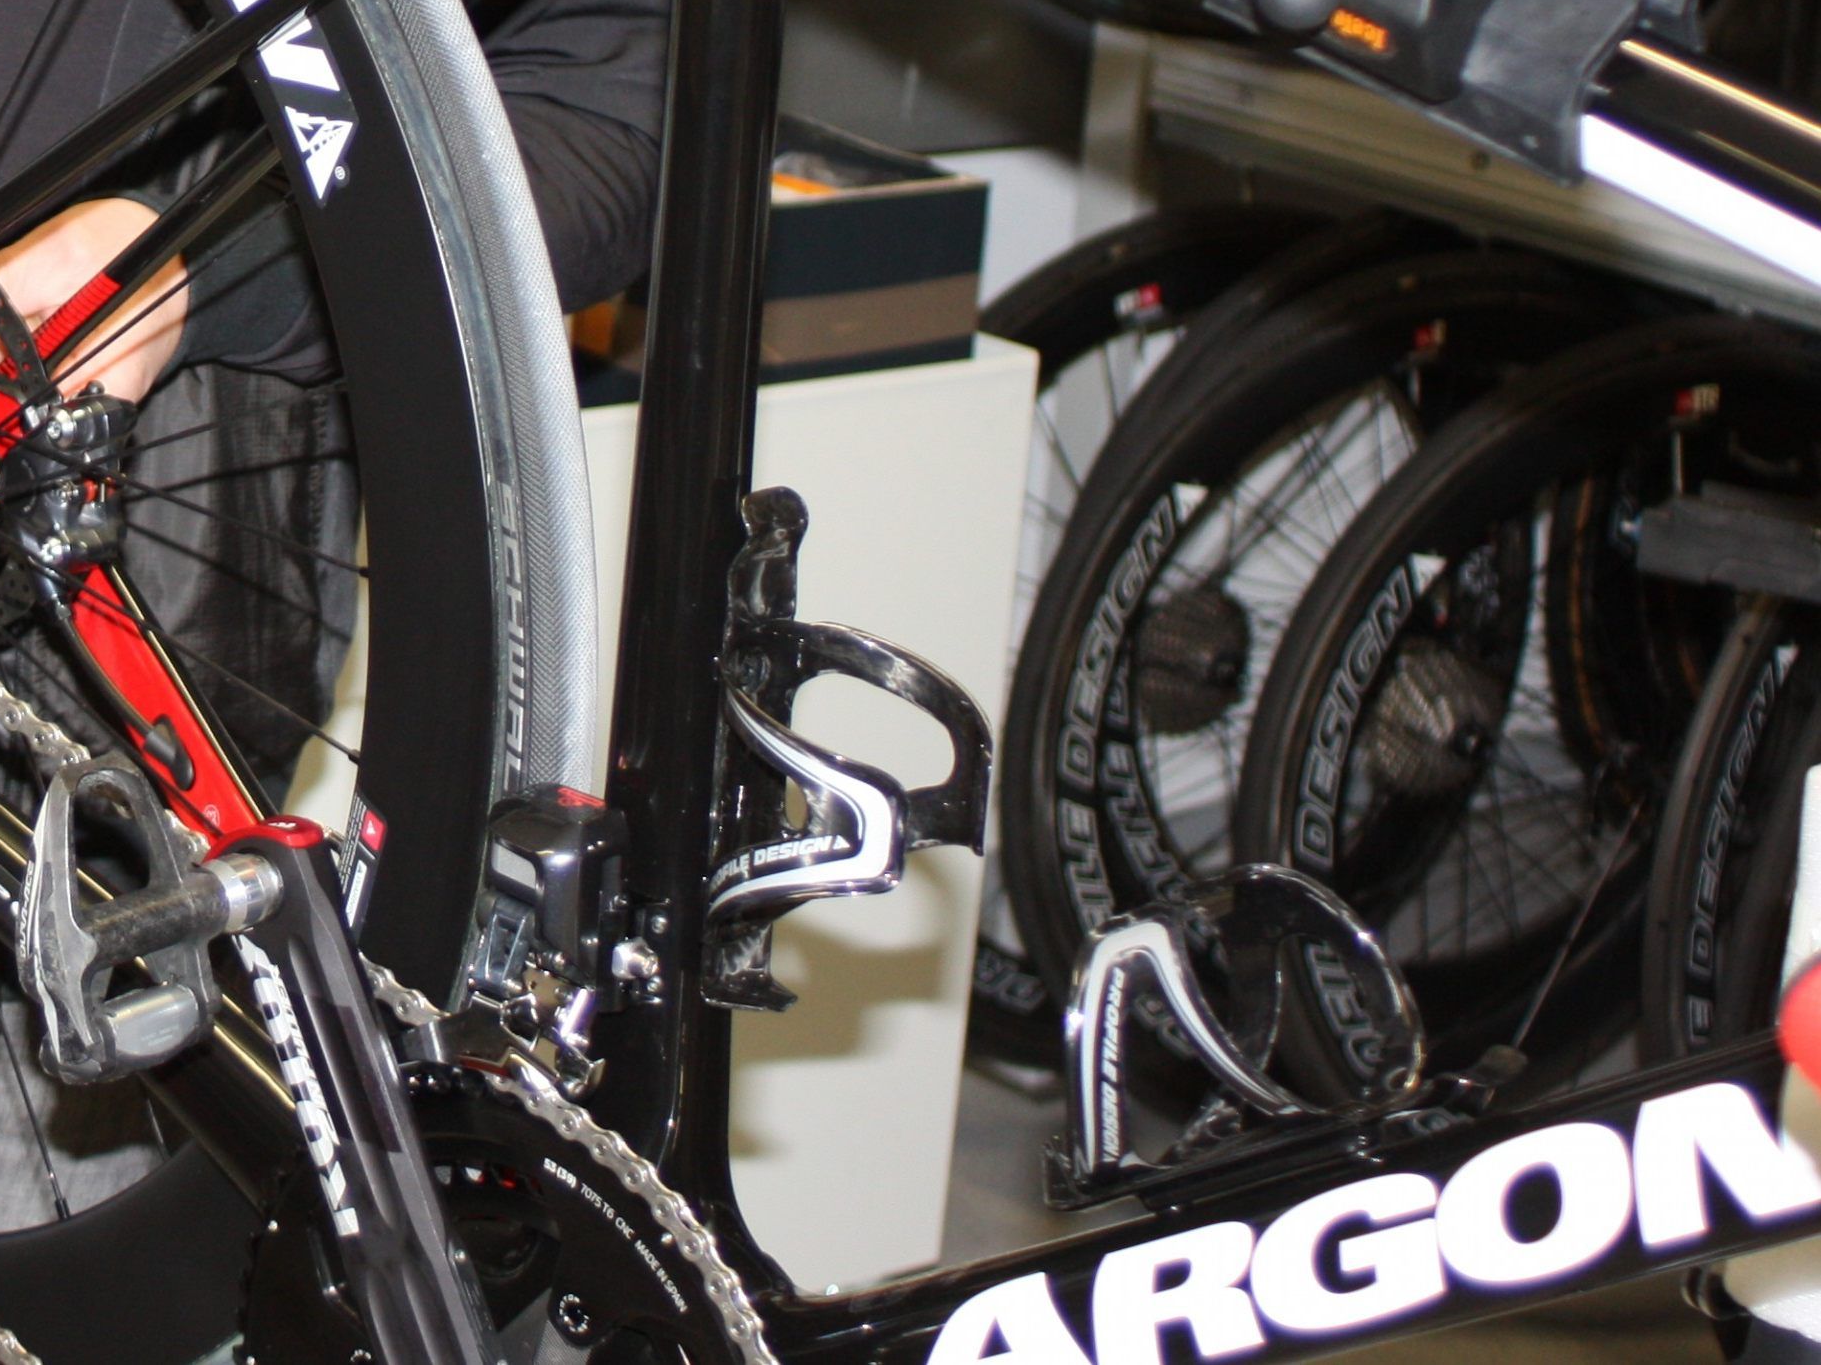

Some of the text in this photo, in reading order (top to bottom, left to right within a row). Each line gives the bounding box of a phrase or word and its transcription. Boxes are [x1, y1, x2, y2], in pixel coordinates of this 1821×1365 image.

[498, 482, 526, 792] SCHWAL
[1057, 493, 1177, 792] DESIGN
[1294, 565, 1414, 870] DESIGN
[753, 834, 834, 867] DESIGN
[1101, 967, 1126, 1163] PROFILE DESIGN
[580, 1183, 602, 1208] 7075
[614, 1216, 635, 1240] CNC
[633, 1239, 661, 1271] MADE
[655, 1268, 669, 1283] IN
[664, 1279, 689, 1313] SPAIN
[924, 1081, 1821, 1365] ARGON
